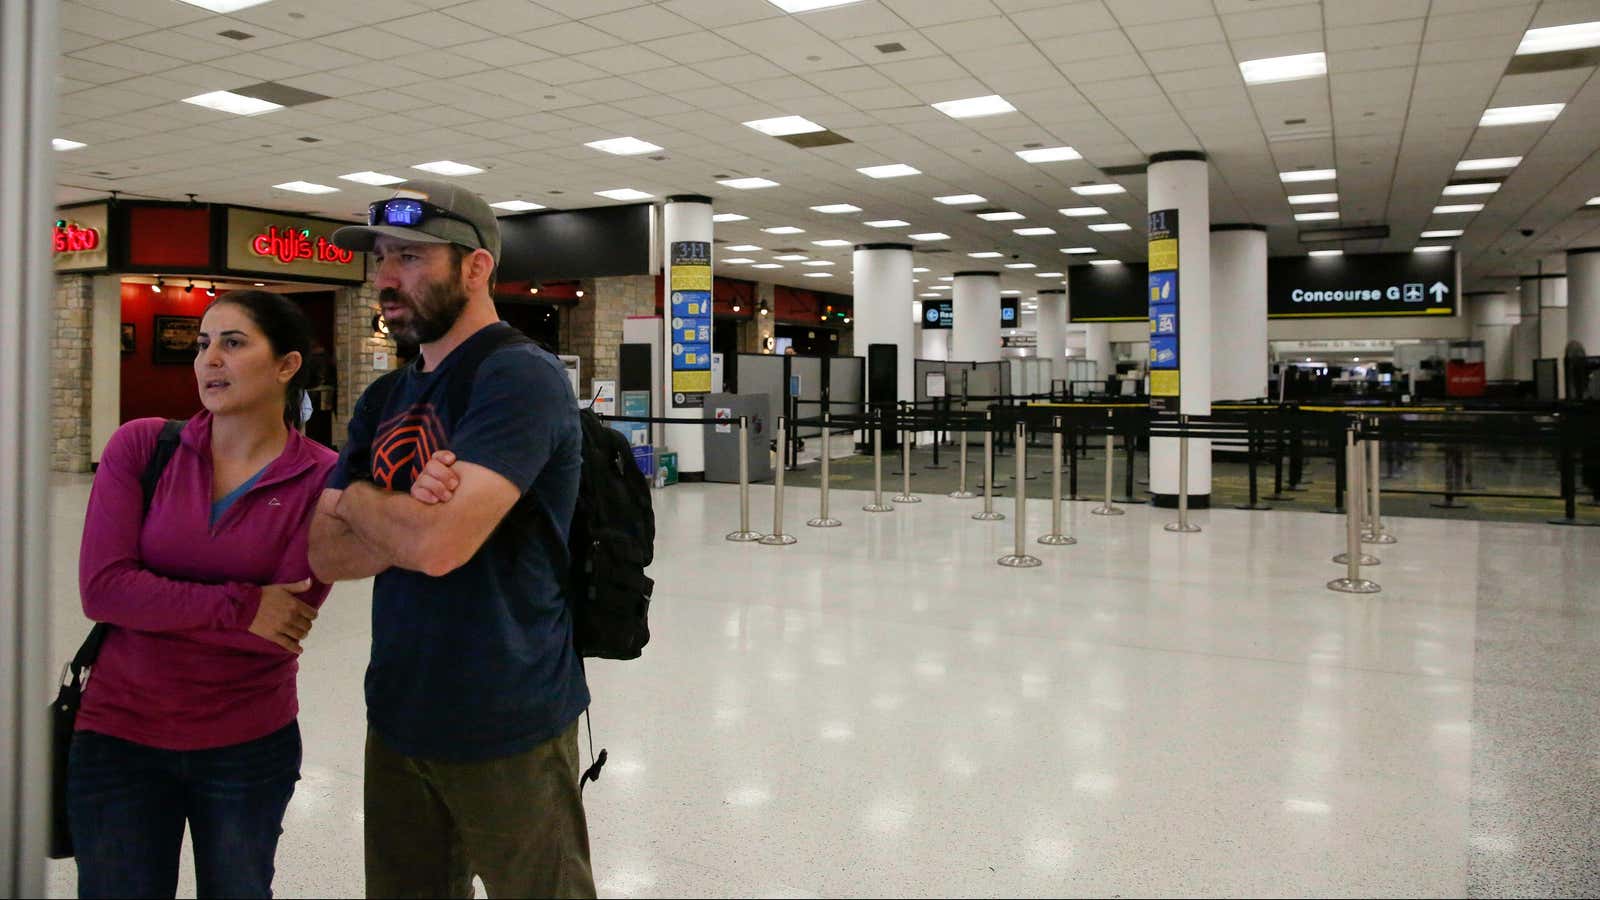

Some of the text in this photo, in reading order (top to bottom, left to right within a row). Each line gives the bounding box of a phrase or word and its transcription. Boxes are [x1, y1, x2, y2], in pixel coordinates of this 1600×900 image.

[317, 236, 353, 264] too
[1291, 286, 1401, 303] Concourse G
